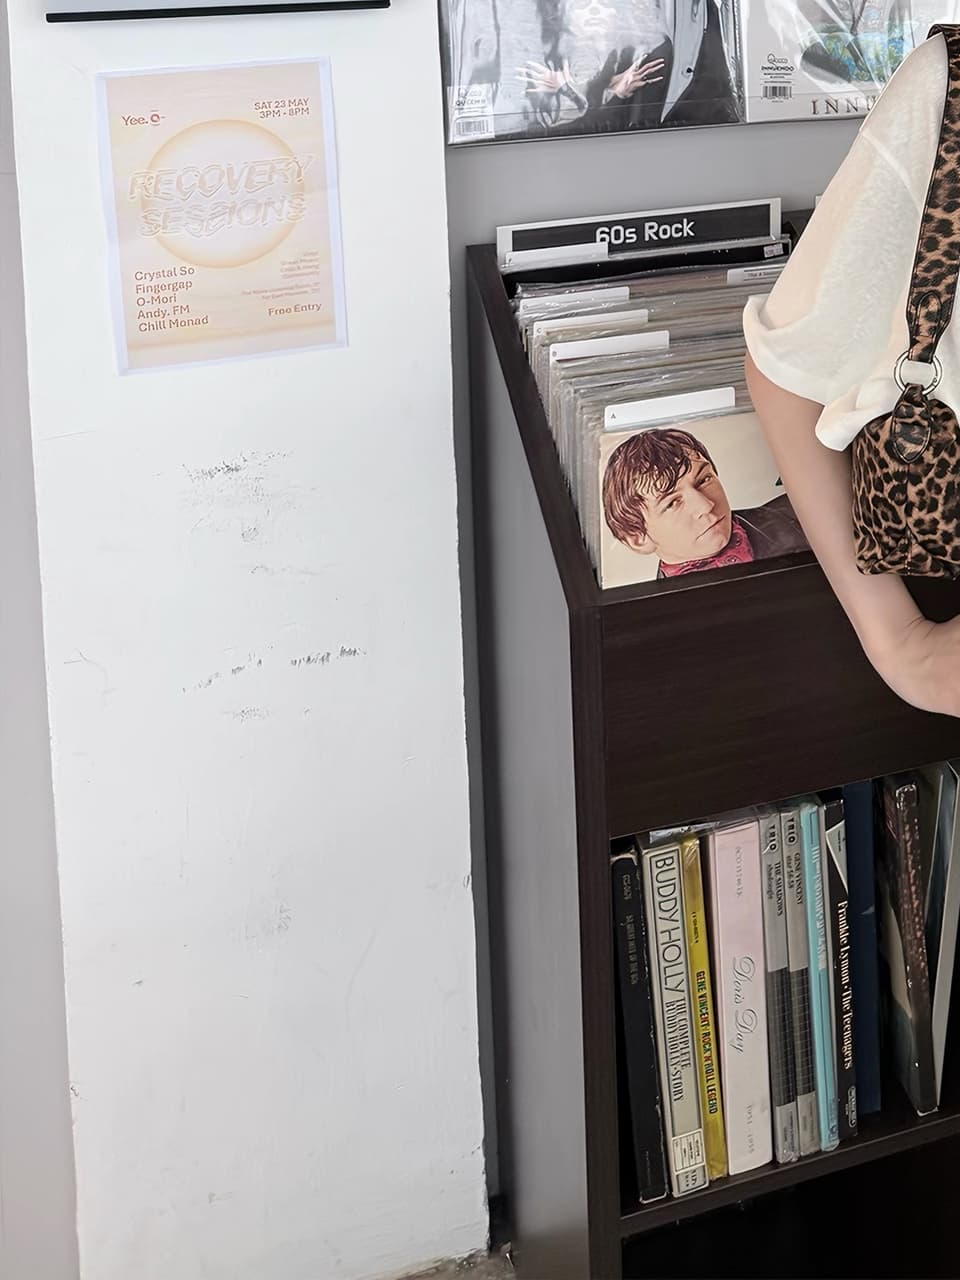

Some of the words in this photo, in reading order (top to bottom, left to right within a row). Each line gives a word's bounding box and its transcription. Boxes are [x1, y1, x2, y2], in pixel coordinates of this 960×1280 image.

[254, 101, 273, 111] SAT
[274, 99, 286, 109] 23
[288, 97, 310, 108] MAY
[259, 108, 279, 119] 3PM
[811, 95, 877, 115] INNU
[128, 154, 315, 201] RECOVERY
[138, 194, 306, 238] SESSIONS
[596, 224, 637, 245] 60s
[644, 218, 695, 241] Rock
[134, 267, 178, 282] Crystal
[179, 266, 195, 277] So
[135, 279, 193, 296] Fingergap
[136, 294, 177, 307] O-Mori
[137, 308, 171, 322] Andy.
[173, 305, 190, 316] FM
[268, 307, 292, 316] Free
[294, 303, 322, 312] Entry
[138, 321, 166, 333] Chill
[168, 315, 209, 329] Monad
[611, 412, 617, 420] A
[768, 825, 777, 851] TRIO
[788, 818, 796, 843] TRIO
[655, 856, 680, 922] BUDDY
[775, 876, 783, 916] SHADOWS
[838, 900, 850, 945] Frankie
[660, 926, 685, 992] HOLLY
[696, 970, 707, 992] GENE
[733, 955, 756, 1005] Doris
[665, 1000, 678, 1033] BUDDY
[676, 997, 687, 1014] THE
[698, 992, 710, 1028] VINCENT
[677, 1017, 692, 1070] COMPLETE
[730, 1008, 758, 1055] Day
[842, 1010, 853, 1070] Teenagers
[706, 1084, 718, 1114] LEGEND
